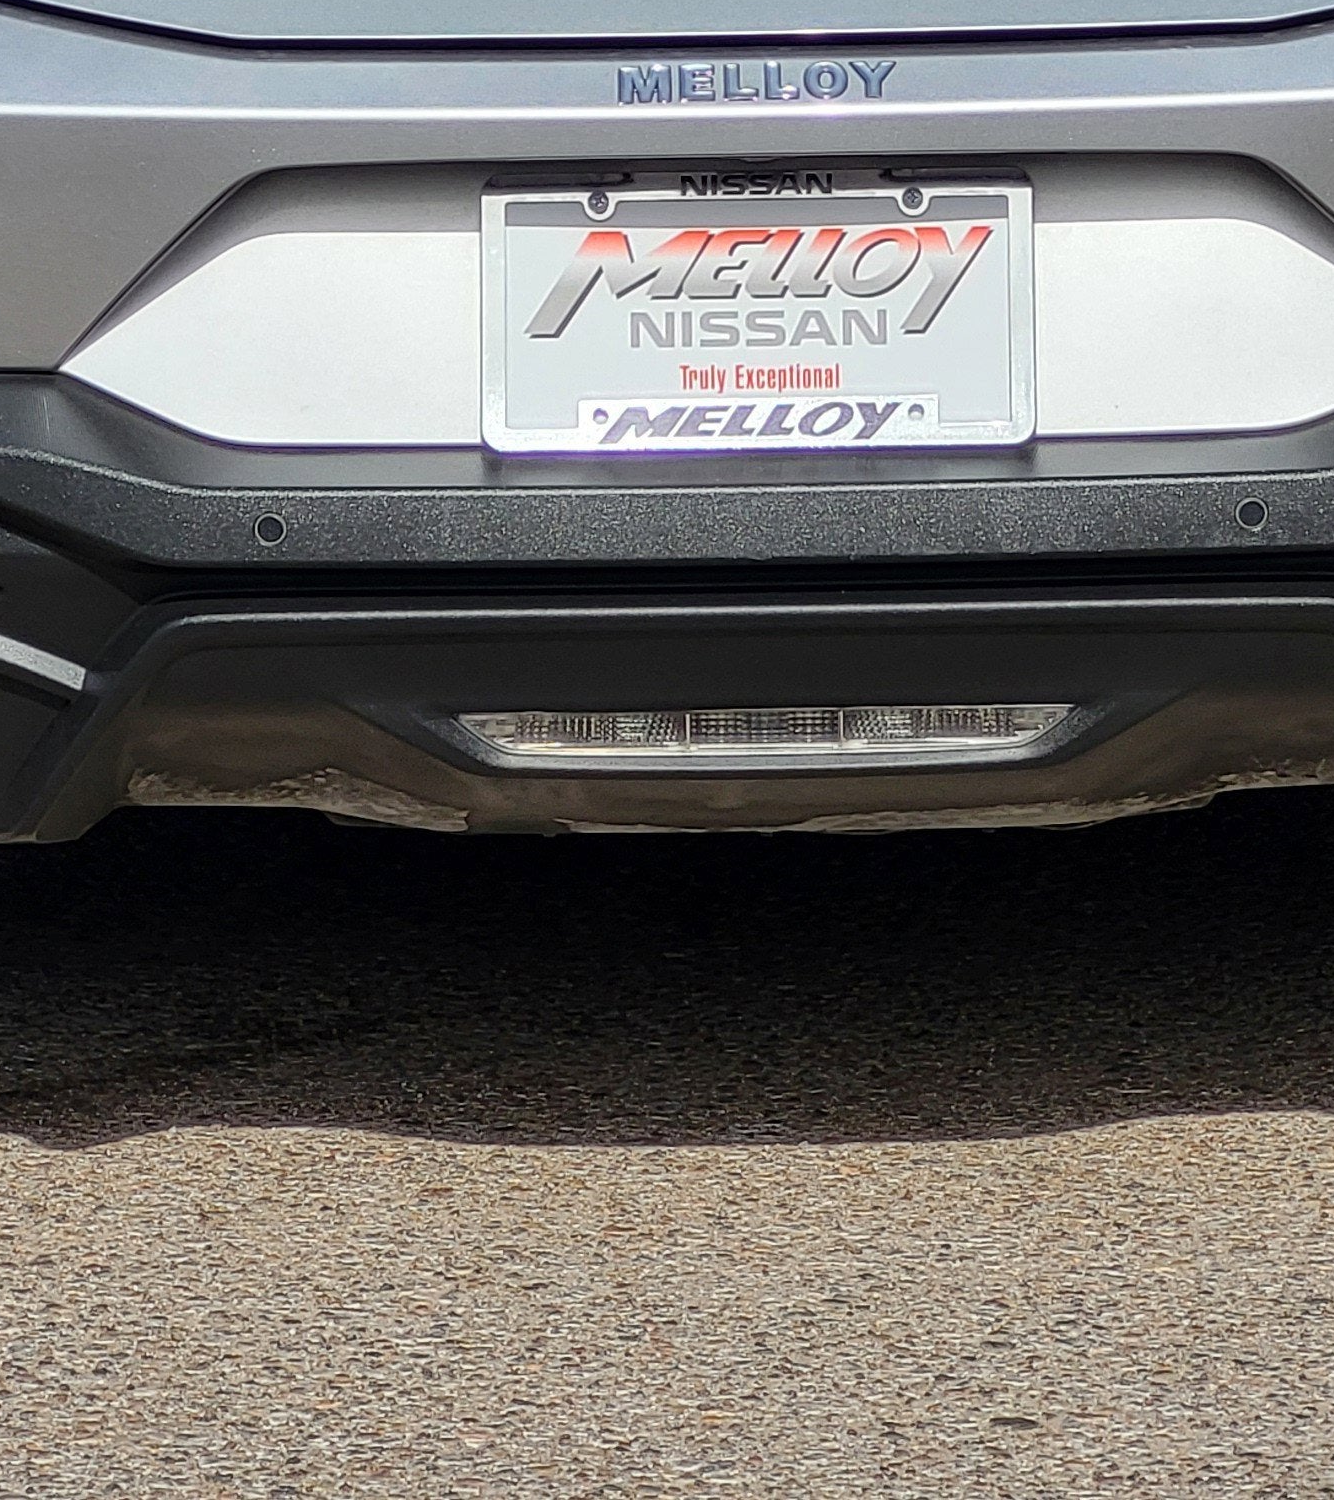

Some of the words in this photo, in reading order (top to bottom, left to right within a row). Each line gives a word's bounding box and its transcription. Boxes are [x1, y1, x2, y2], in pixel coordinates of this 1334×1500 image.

[617, 60, 897, 105] MELLOY
[680, 172, 833, 196] NISSAN
[629, 308, 888, 348] NISSAN
[679, 364, 726, 393] Truly
[734, 362, 842, 393] Exceptional
[598, 400, 904, 444] MELLOY
